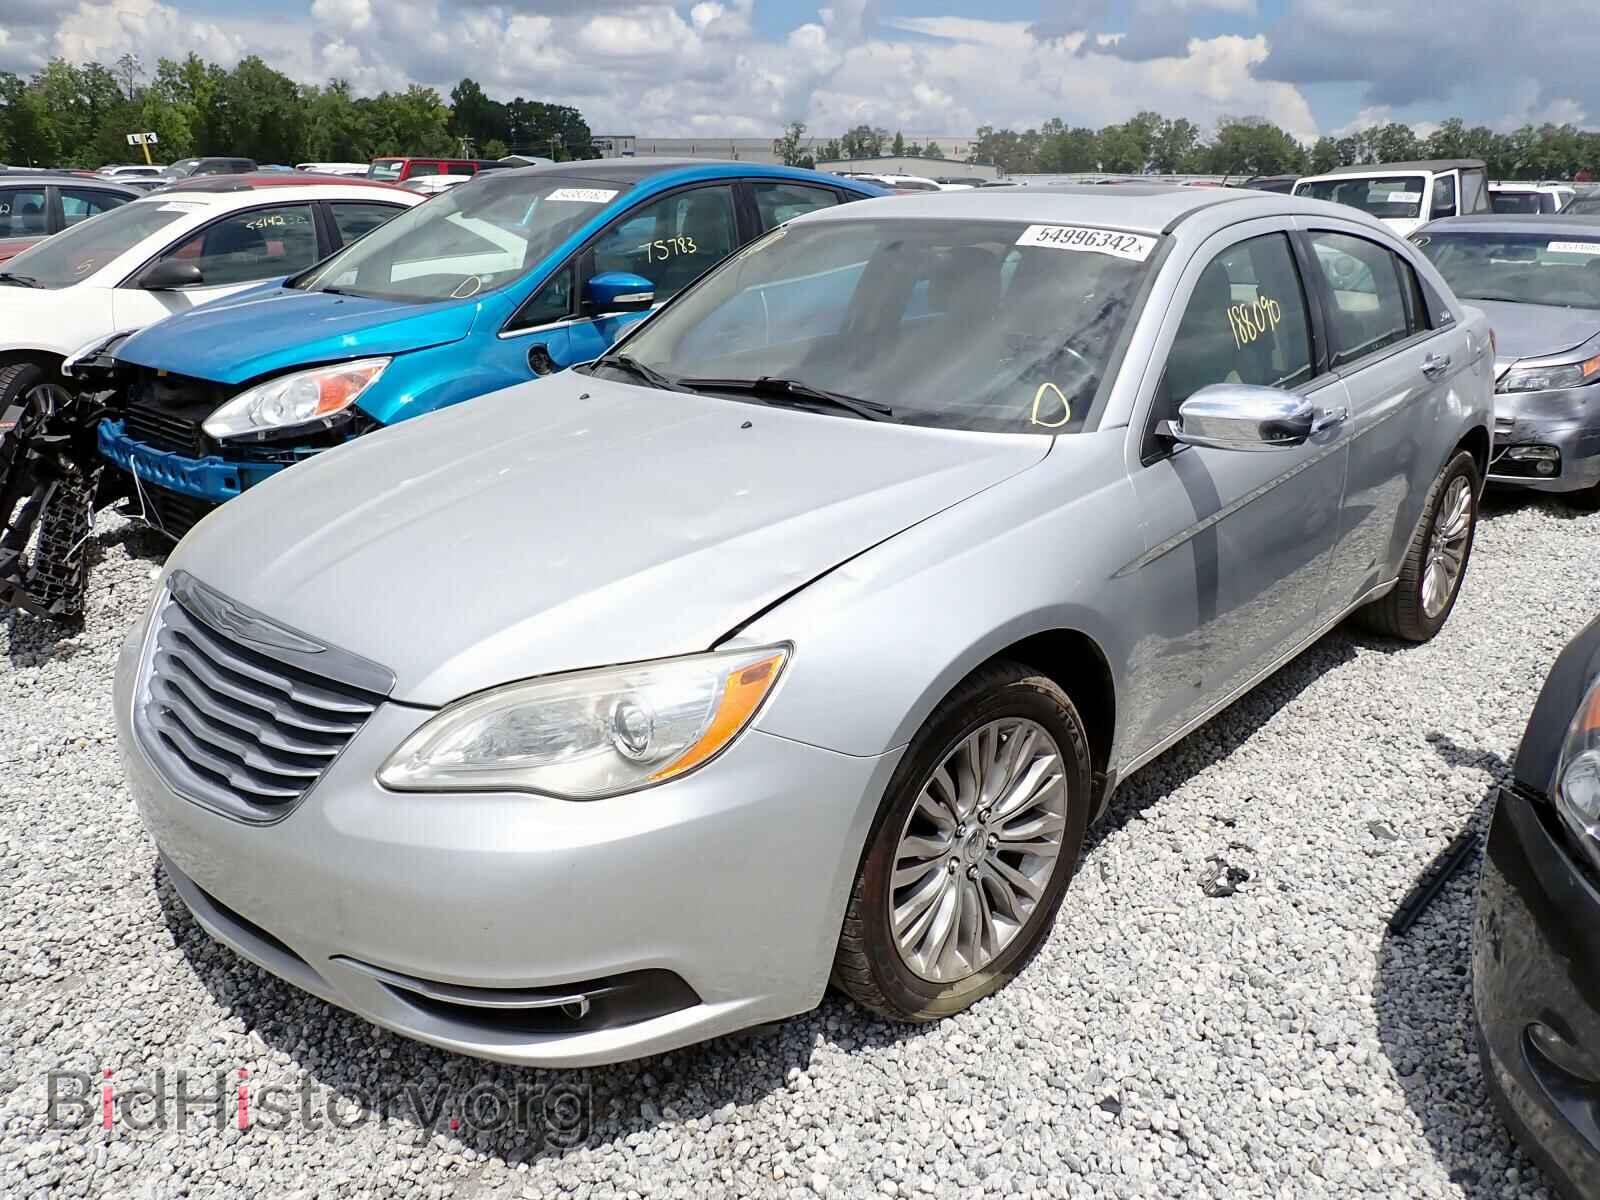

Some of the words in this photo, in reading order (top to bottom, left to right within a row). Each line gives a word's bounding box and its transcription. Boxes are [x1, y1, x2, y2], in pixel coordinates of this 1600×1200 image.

[131, 135, 140, 144] L
[144, 134, 154, 143] K
[638, 236, 697, 263] 75783
[1227, 295, 1281, 350] 188090
